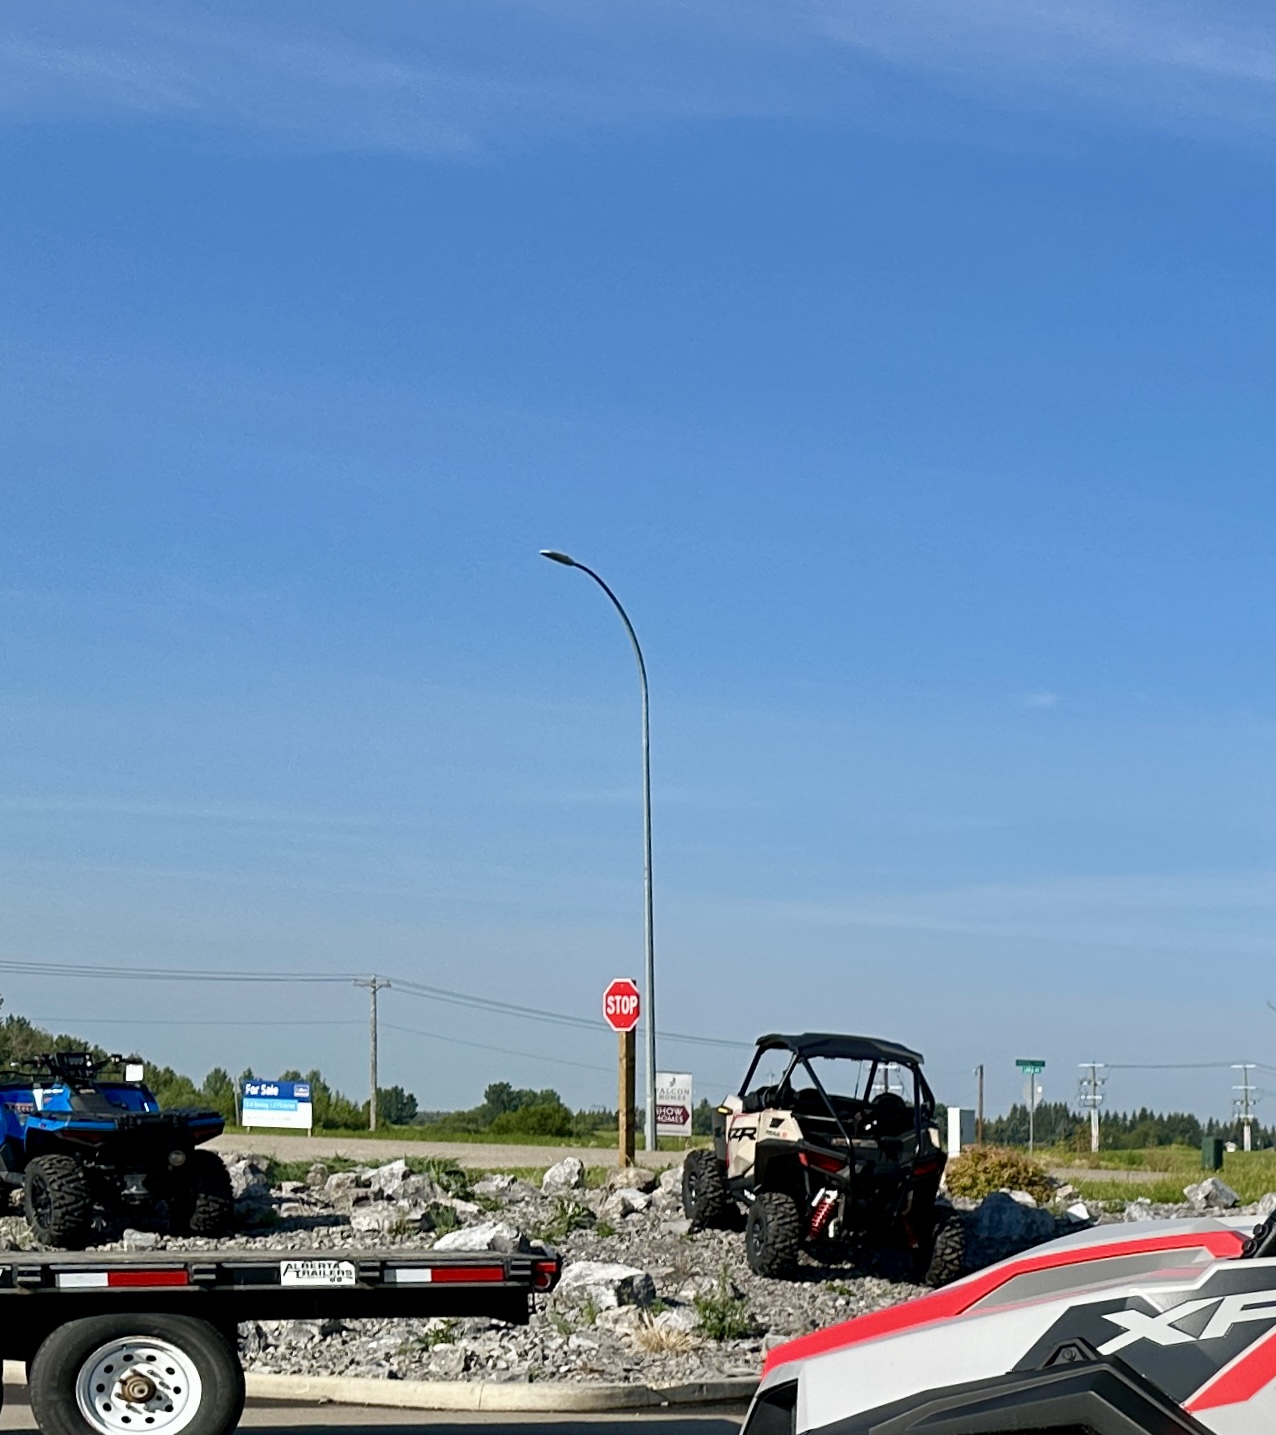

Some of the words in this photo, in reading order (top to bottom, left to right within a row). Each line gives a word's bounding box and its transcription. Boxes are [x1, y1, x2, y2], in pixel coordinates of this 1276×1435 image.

[606, 995, 638, 1015] STOP
[245, 1083, 260, 1096] For
[261, 1083, 279, 1096] Sale
[283, 1262, 340, 1276] ALBERTA
[295, 1269, 354, 1279] TRAILERS
